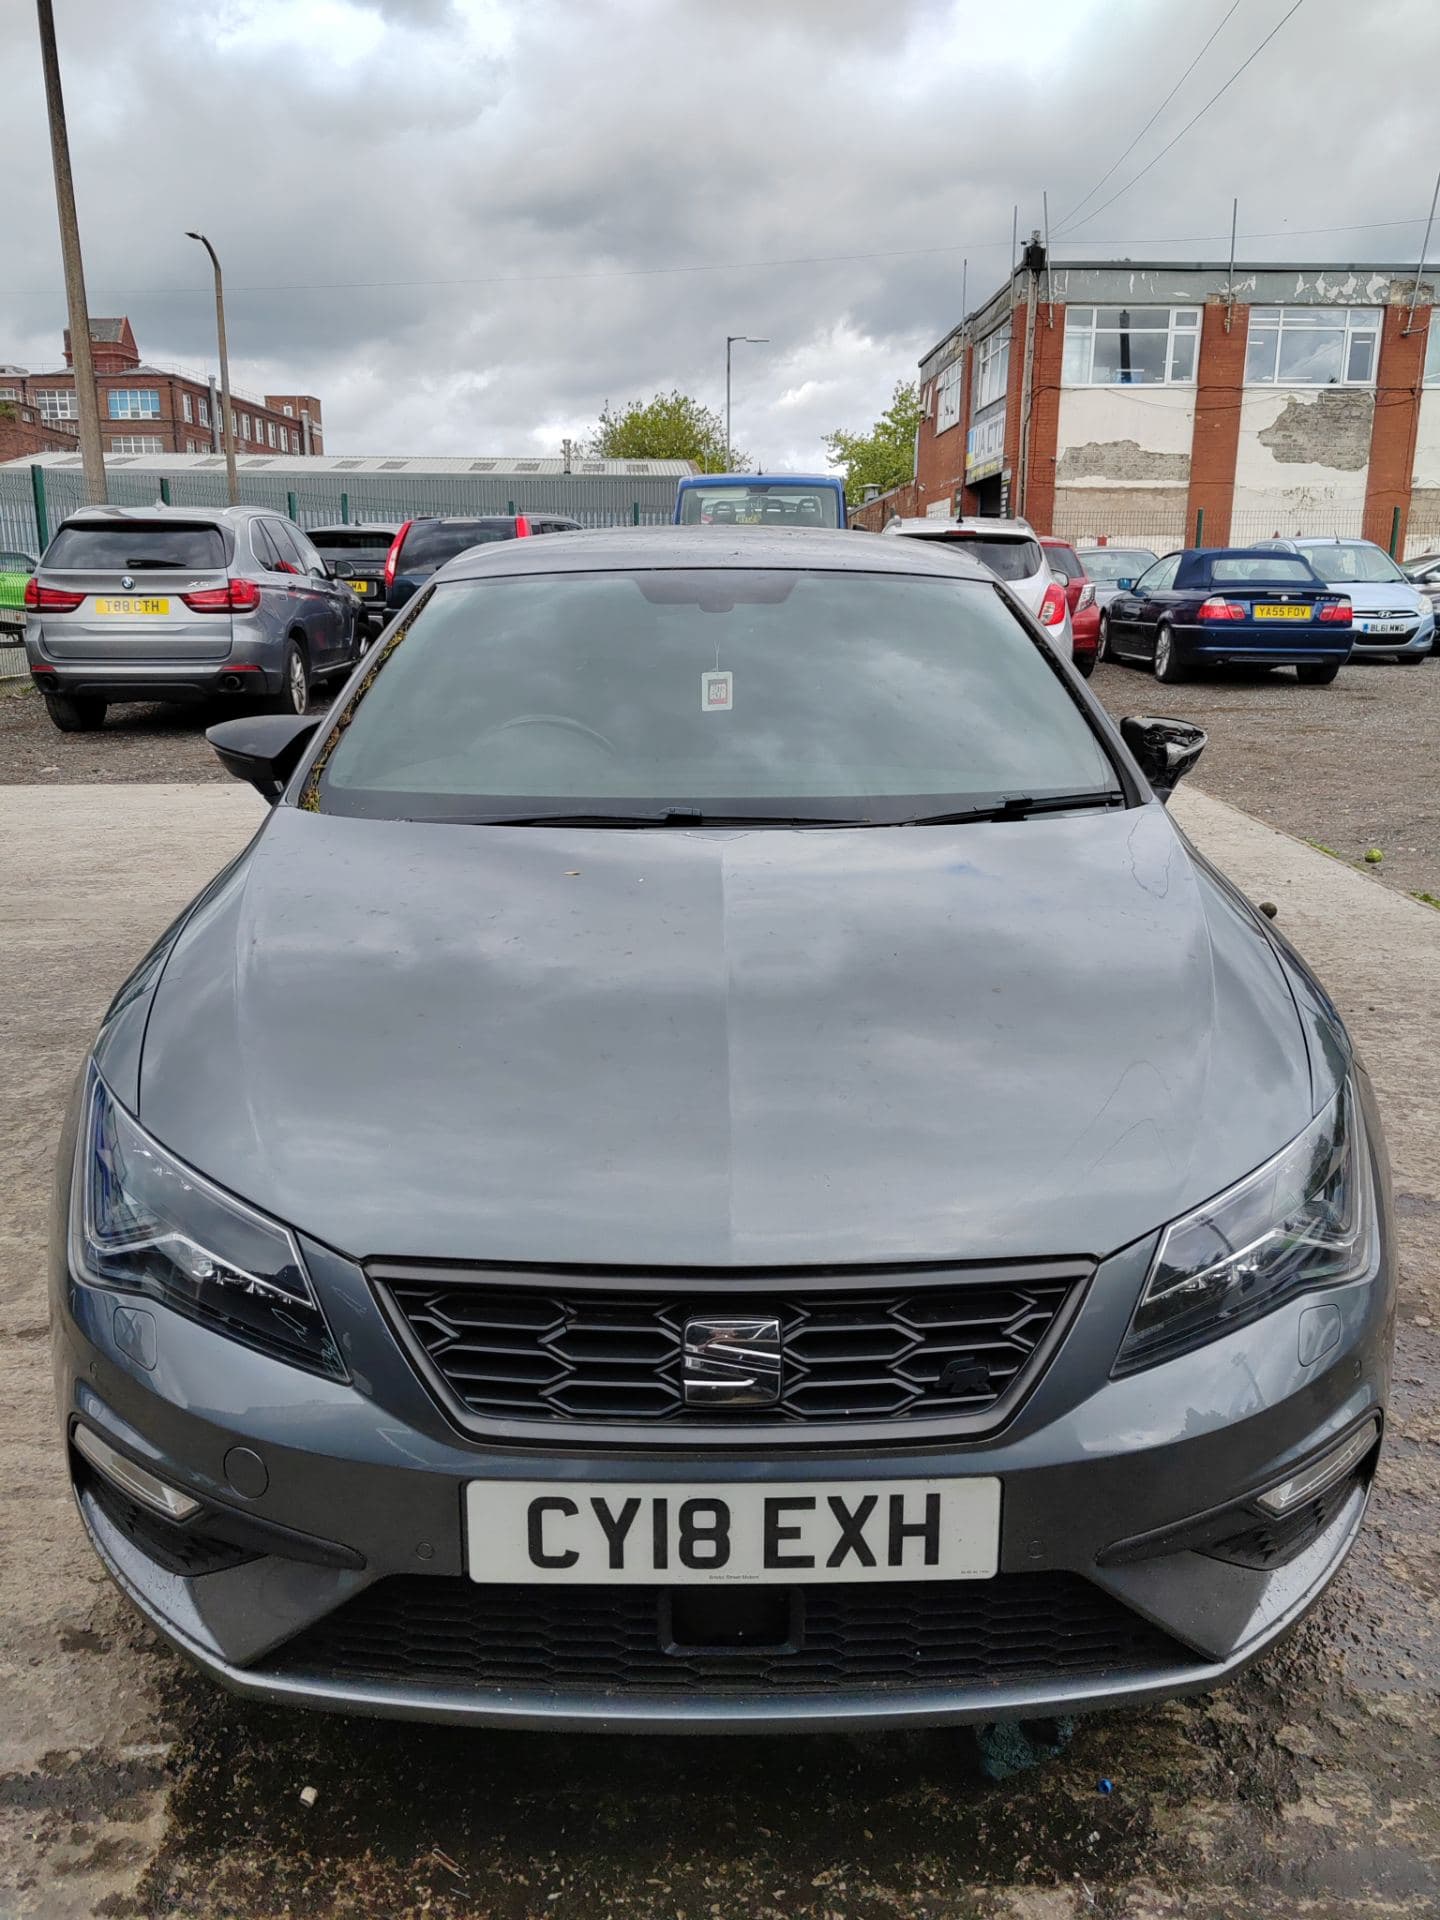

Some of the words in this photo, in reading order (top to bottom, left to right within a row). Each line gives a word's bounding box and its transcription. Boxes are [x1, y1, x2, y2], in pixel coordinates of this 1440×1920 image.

[105, 600, 130, 612] T88
[133, 600, 160, 612] CTH
[1259, 607, 1285, 617] YA55
[1370, 623, 1388, 632] BL61
[527, 1496, 731, 1569] CY18
[763, 1493, 941, 1569] EXH
